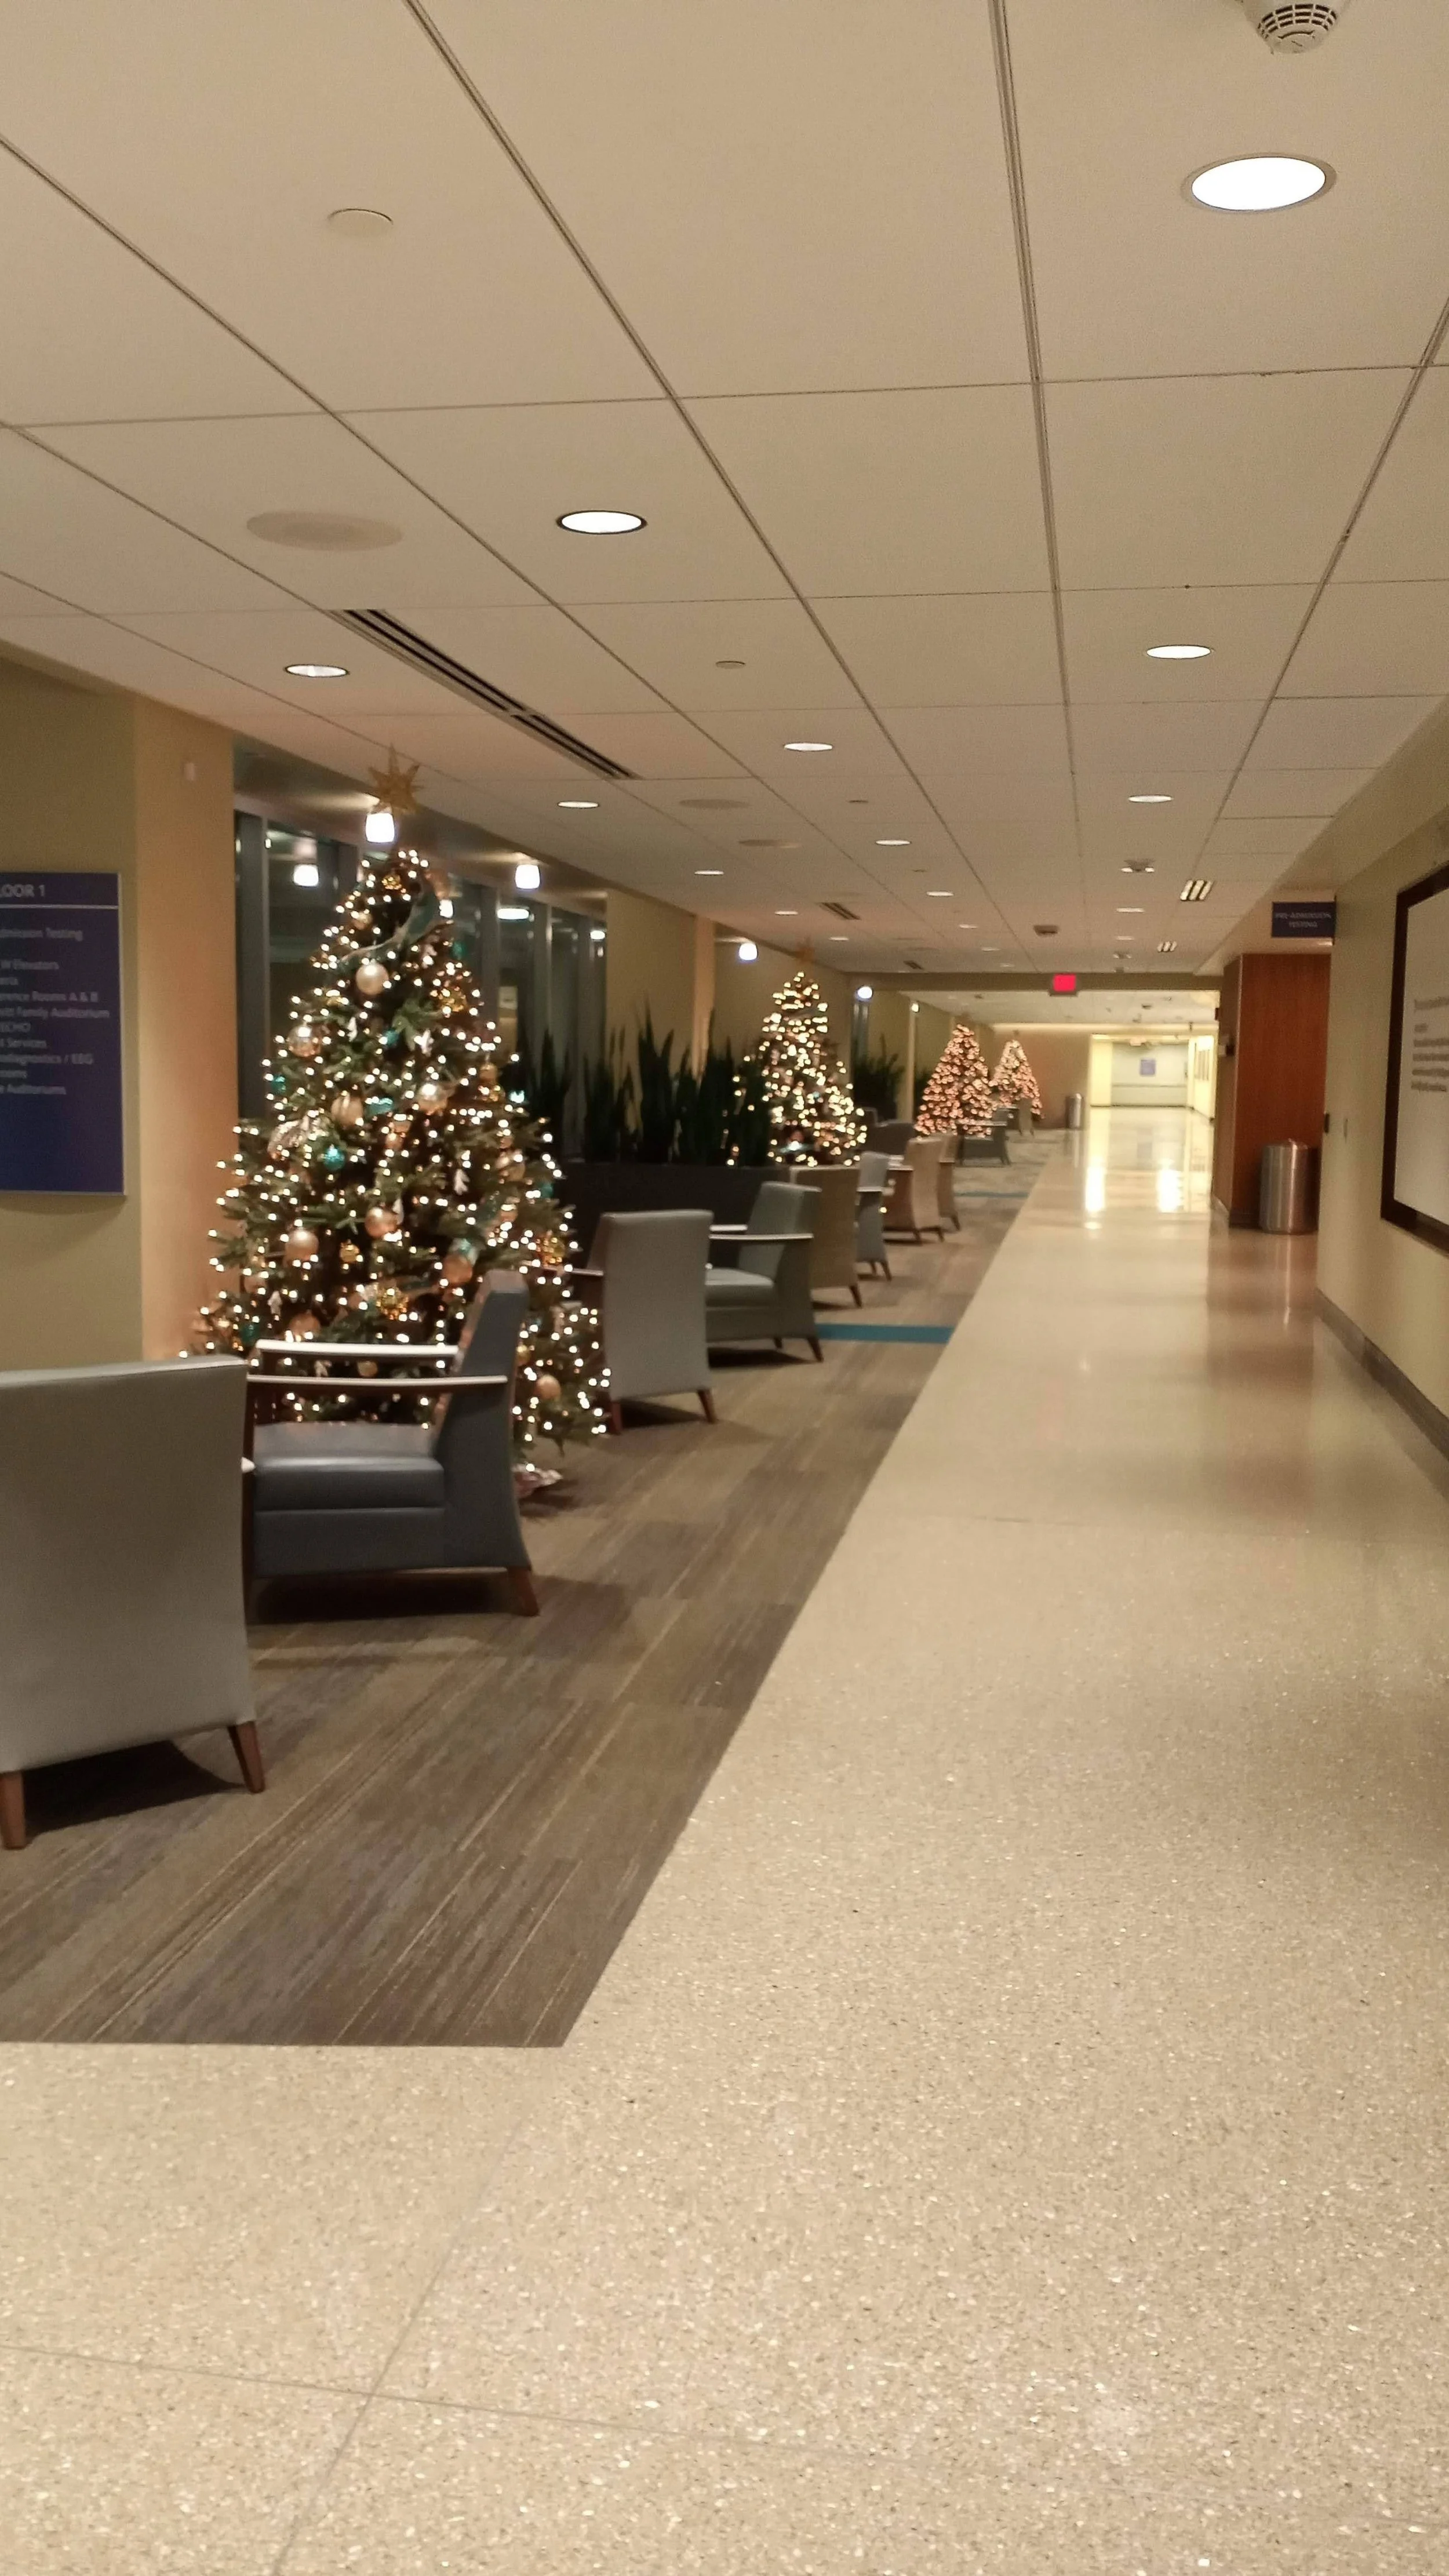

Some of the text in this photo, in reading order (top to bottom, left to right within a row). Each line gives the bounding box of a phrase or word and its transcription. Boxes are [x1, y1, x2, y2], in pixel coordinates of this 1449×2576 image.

[0, 884, 45, 898] OOR 1
[45, 927, 83, 942] Testing
[68, 992, 78, 1002] A
